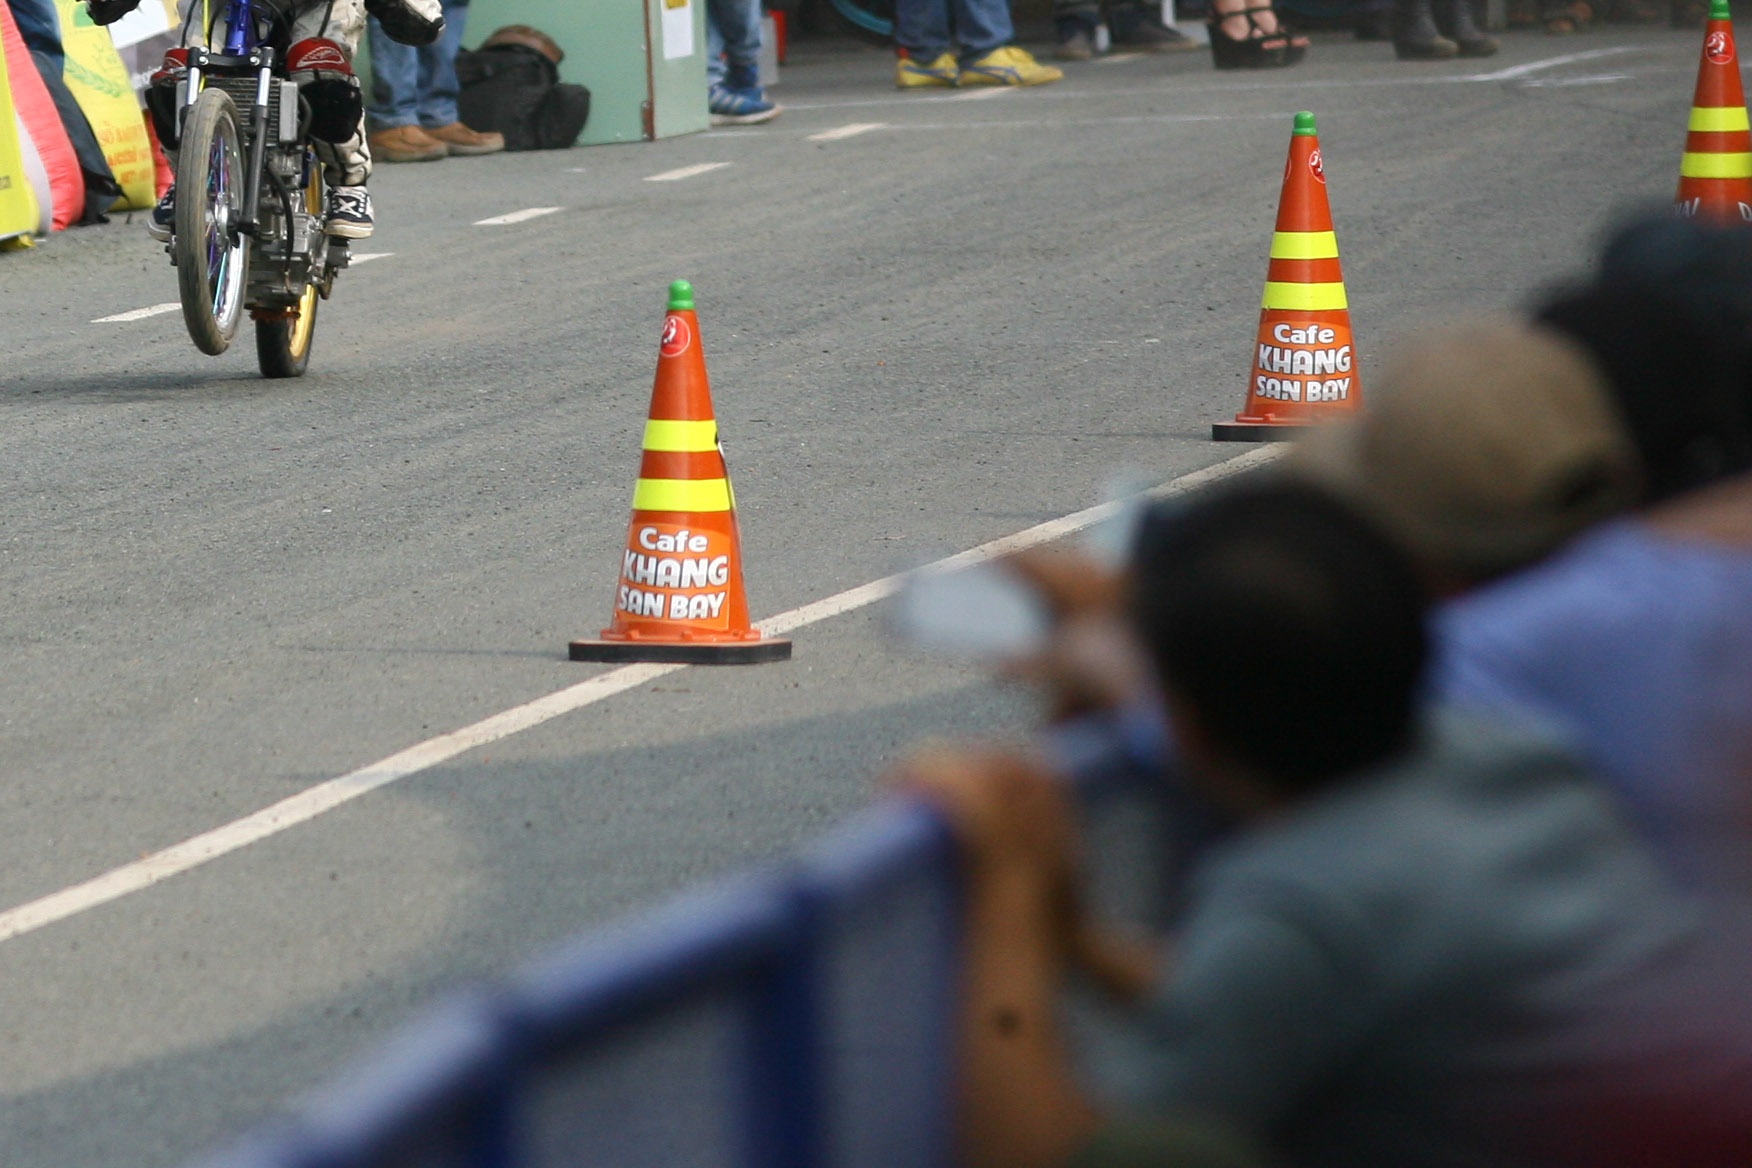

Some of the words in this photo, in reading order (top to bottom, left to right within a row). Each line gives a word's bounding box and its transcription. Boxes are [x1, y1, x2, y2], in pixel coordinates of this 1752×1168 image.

[1273, 323, 1336, 345] Cafe
[1258, 344, 1351, 375] KHANG
[1256, 375, 1301, 402] SAN
[1306, 377, 1351, 403] BAY
[638, 528, 708, 553] Cafe
[624, 550, 728, 589] KHANG
[619, 585, 666, 619] SAN
[669, 592, 727, 620] BAY
